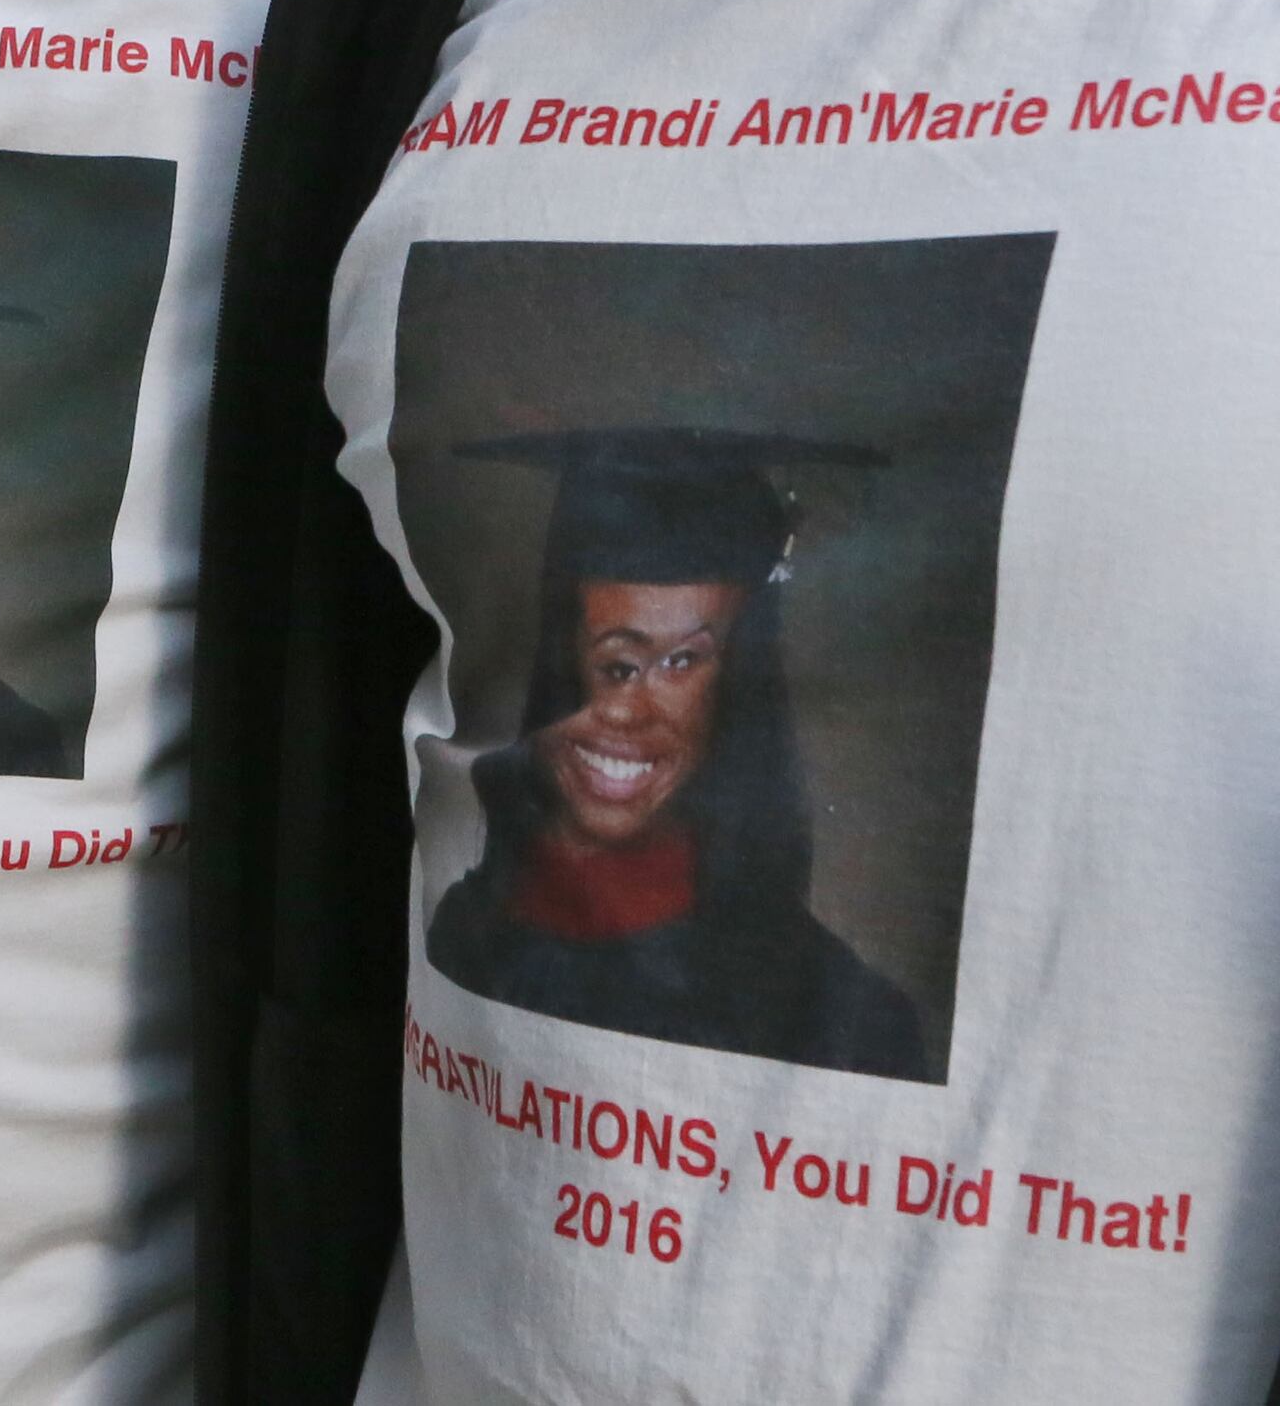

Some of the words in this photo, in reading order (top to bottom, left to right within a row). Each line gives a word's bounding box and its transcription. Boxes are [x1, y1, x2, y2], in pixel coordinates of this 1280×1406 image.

[170, 36, 261, 91] Mc
[519, 98, 720, 148] Brandi
[728, 88, 1049, 147] Ann'Marie
[48, 827, 134, 869] Did
[754, 1131, 871, 1209] You
[895, 1154, 994, 1229] Did
[1019, 1173, 1193, 1254] That!
[553, 1183, 684, 1264] 2016
